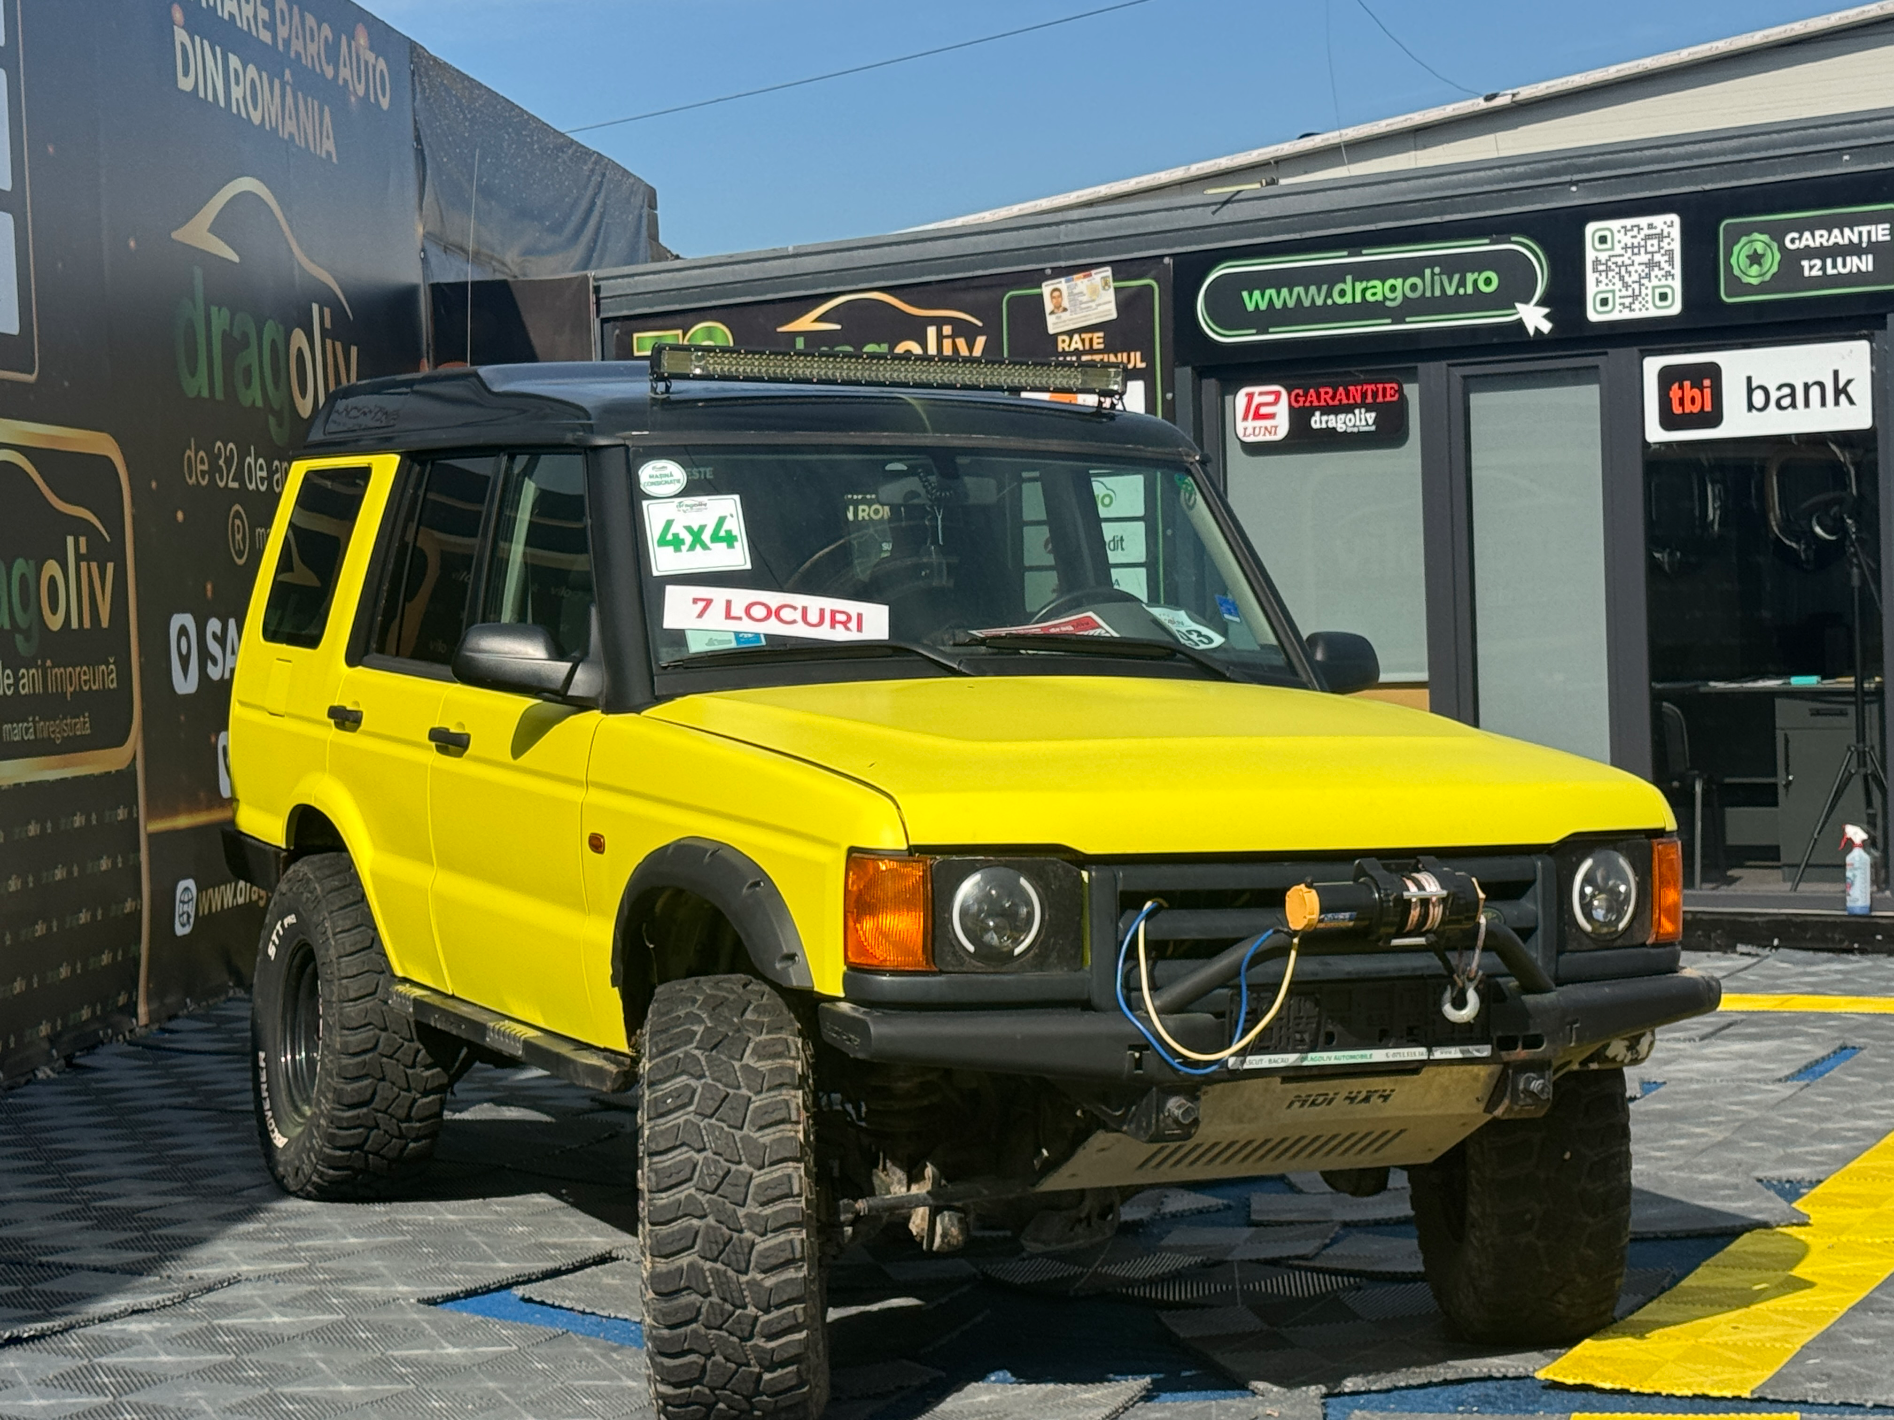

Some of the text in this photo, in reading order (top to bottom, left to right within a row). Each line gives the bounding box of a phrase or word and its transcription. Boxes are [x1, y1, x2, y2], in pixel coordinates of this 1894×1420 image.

[275, 0, 334, 80] PARC
[338, 33, 391, 111] AUTO
[173, 24, 338, 164] DIN ROMÂNIA
[1801, 253, 1874, 278] 12 LUNI
[1241, 266, 1499, 312] www.dragoliv.ro
[174, 264, 358, 447] dragoliv
[1057, 331, 1105, 352] RATE
[1241, 390, 1282, 422] 12
[1290, 382, 1400, 408] GARANTIE
[1669, 368, 1857, 415] tbi bank
[1241, 425, 1280, 438] LUNI
[1310, 407, 1377, 432] dragoliv
[184, 437, 209, 486] de
[214, 440, 240, 489] 32
[244, 444, 268, 493] de
[657, 515, 739, 553] 4x4
[1105, 535, 1126, 552] dit
[692, 597, 864, 633] 7 LOCURI
[19, 659, 43, 695] ani
[46, 656, 118, 701] împreună
